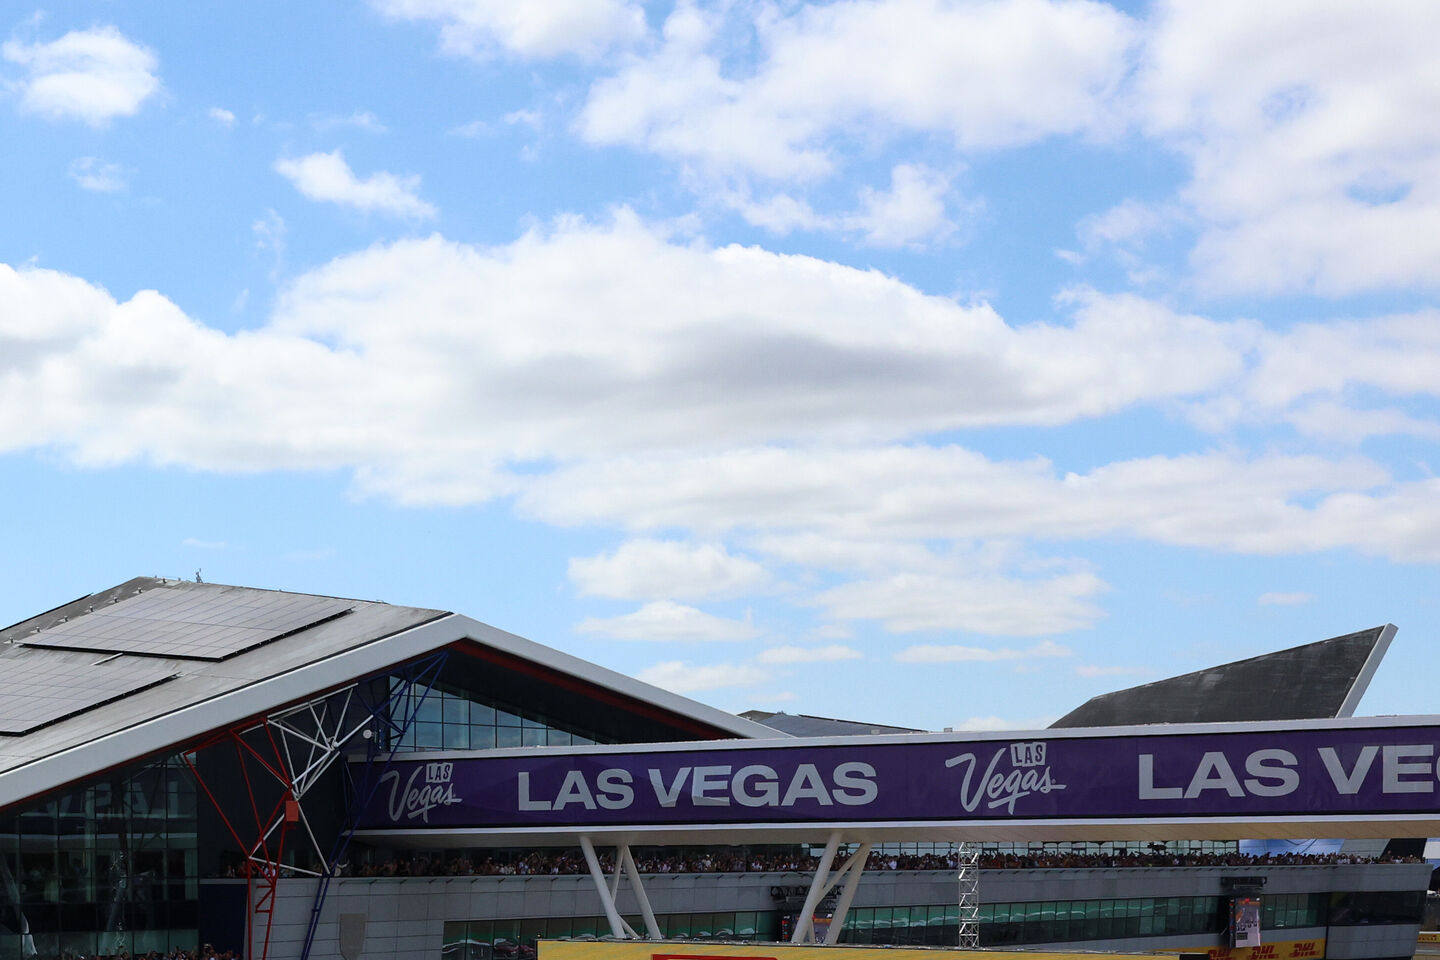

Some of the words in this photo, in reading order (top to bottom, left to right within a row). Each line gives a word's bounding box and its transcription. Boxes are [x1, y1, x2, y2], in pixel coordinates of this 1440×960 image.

[428, 763, 451, 783] LAS
[1012, 743, 1045, 766] LAS
[1139, 749, 1299, 799] LAS
[1318, 745, 1440, 794] VE
[382, 766, 462, 823] Vegas
[518, 769, 634, 811] LAS
[649, 762, 878, 808] VEGAS
[945, 748, 1066, 814] Vegas
